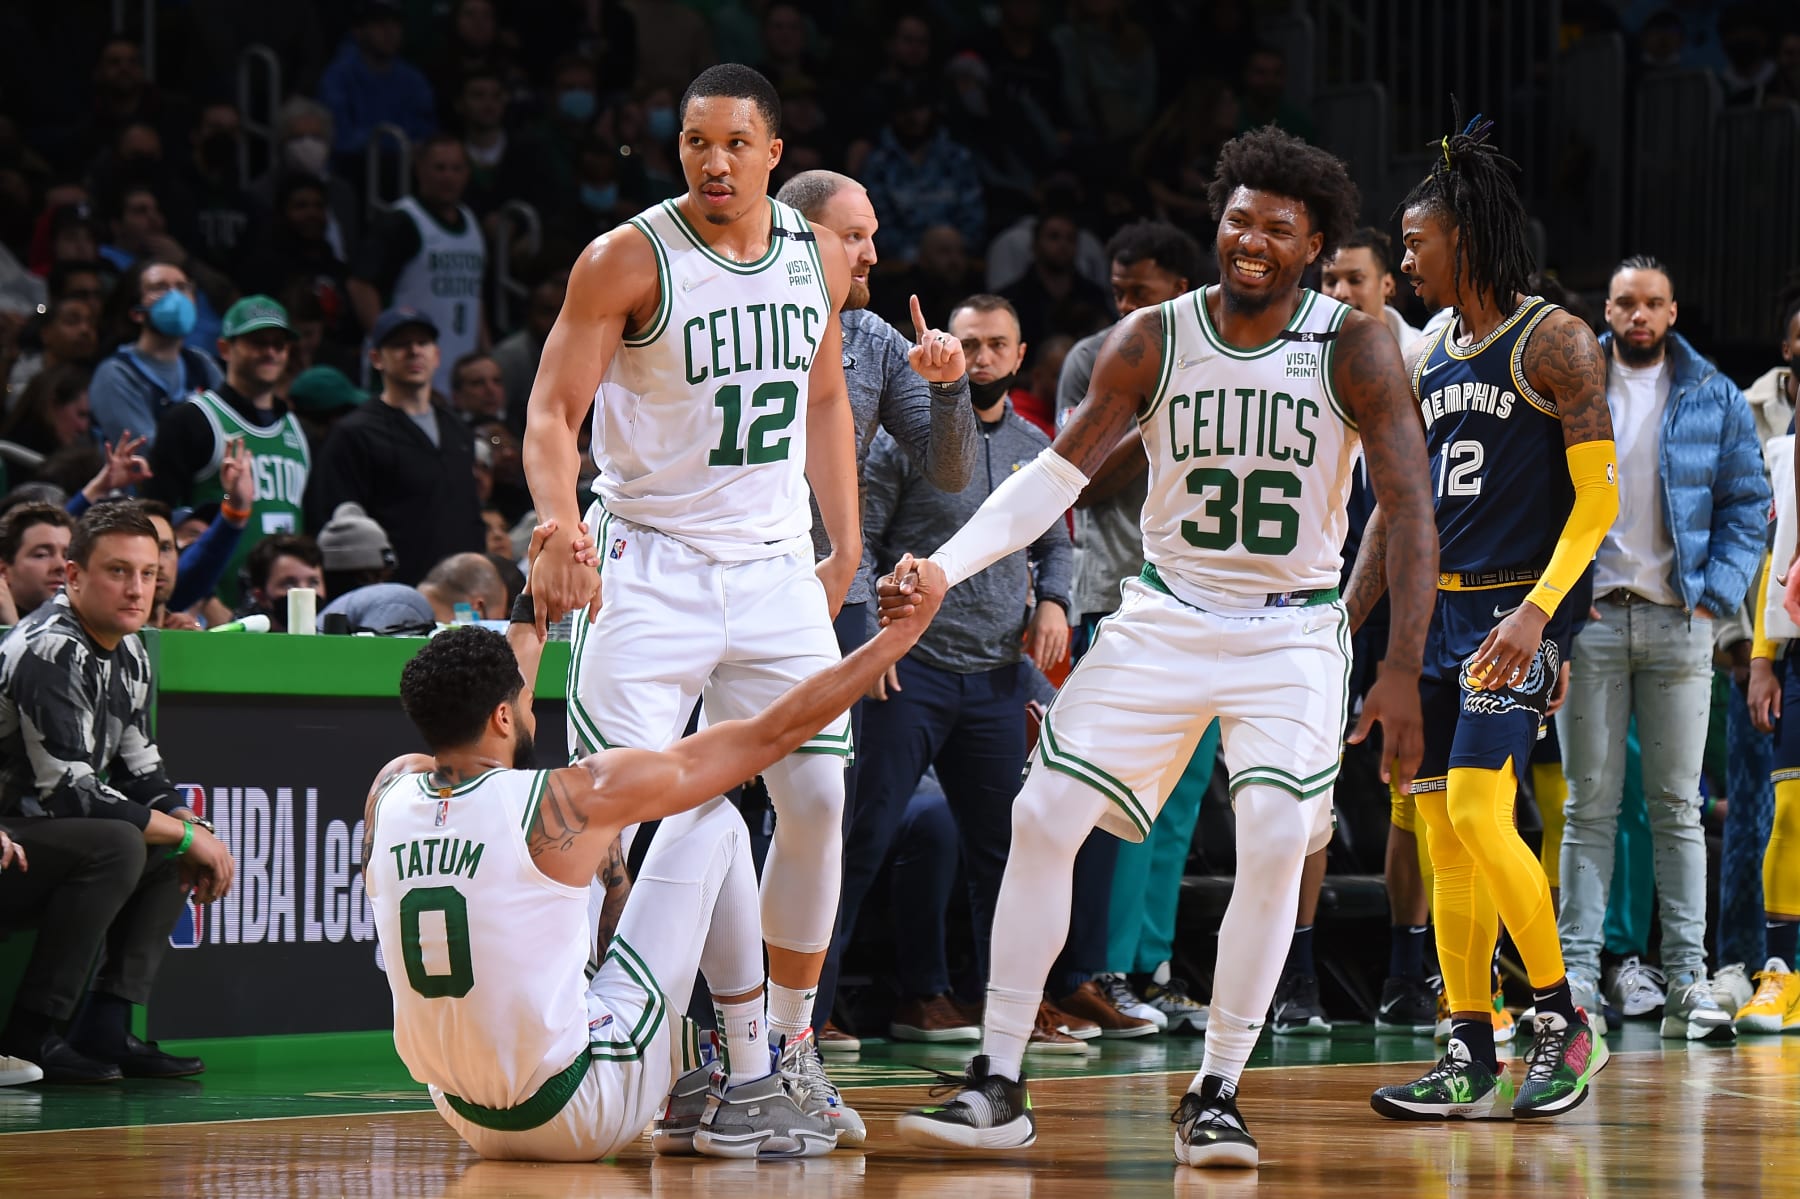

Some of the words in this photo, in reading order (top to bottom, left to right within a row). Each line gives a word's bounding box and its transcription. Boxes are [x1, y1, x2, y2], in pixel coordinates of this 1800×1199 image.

[785, 260, 811, 275] VISTA
[789, 274, 813, 286] PRINT
[683, 303, 819, 385] CELTICS
[1286, 352, 1317, 367] VISTA
[1301, 333, 1314, 341] 24
[1286, 367, 1318, 378] PRINT
[708, 380, 799, 467] 12
[1169, 388, 1319, 468] CELTICS
[1420, 382, 1516, 431] MEMPHIS
[1437, 440, 1484, 498] 12
[1181, 468, 1302, 556] 36
[211, 787, 296, 944] NBA
[390, 838, 485, 881] TATUM
[400, 886, 474, 998] 0
[1444, 1076, 1472, 1102] 12
